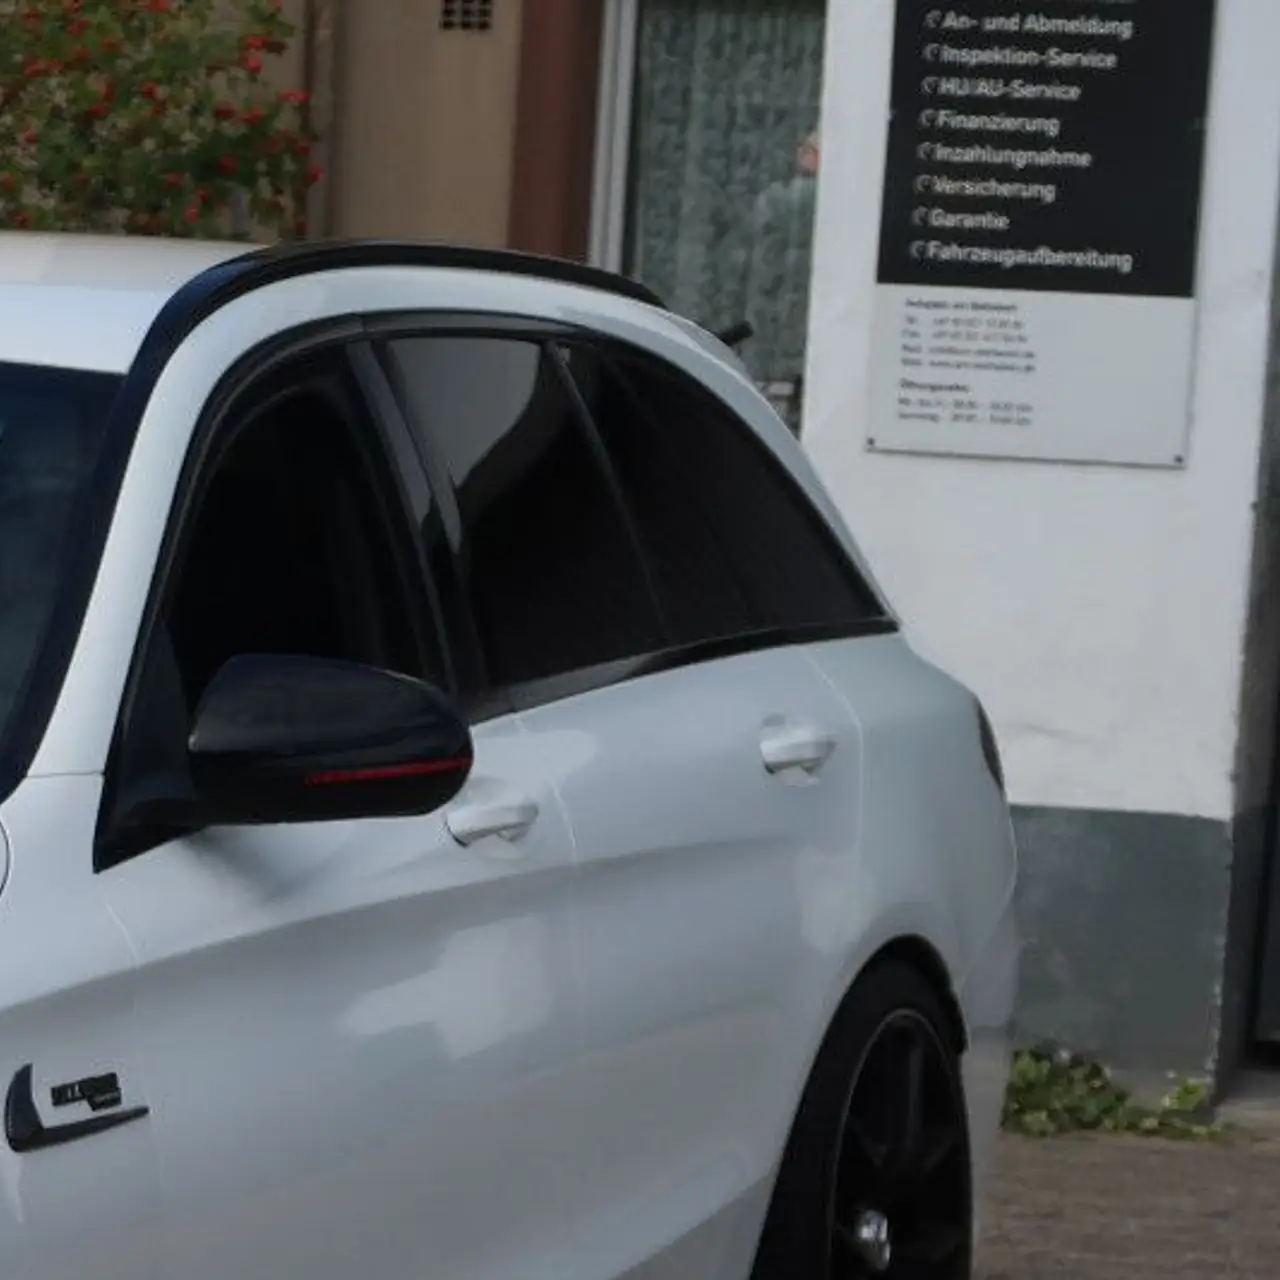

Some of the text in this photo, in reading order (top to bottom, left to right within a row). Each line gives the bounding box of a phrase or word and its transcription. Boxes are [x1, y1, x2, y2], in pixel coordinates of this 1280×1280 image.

[941, 10, 1133, 41] An- und Abmeldung
[941, 45, 1118, 68] Inspektion-Service
[938, 110, 1060, 137] Finanzierung
[935, 143, 1092, 170] Inzahlungnahme
[934, 175, 1056, 203] Versicherung
[928, 208, 1010, 229] Garantie
[928, 240, 1133, 273] Fahrzeugaufbereitung
